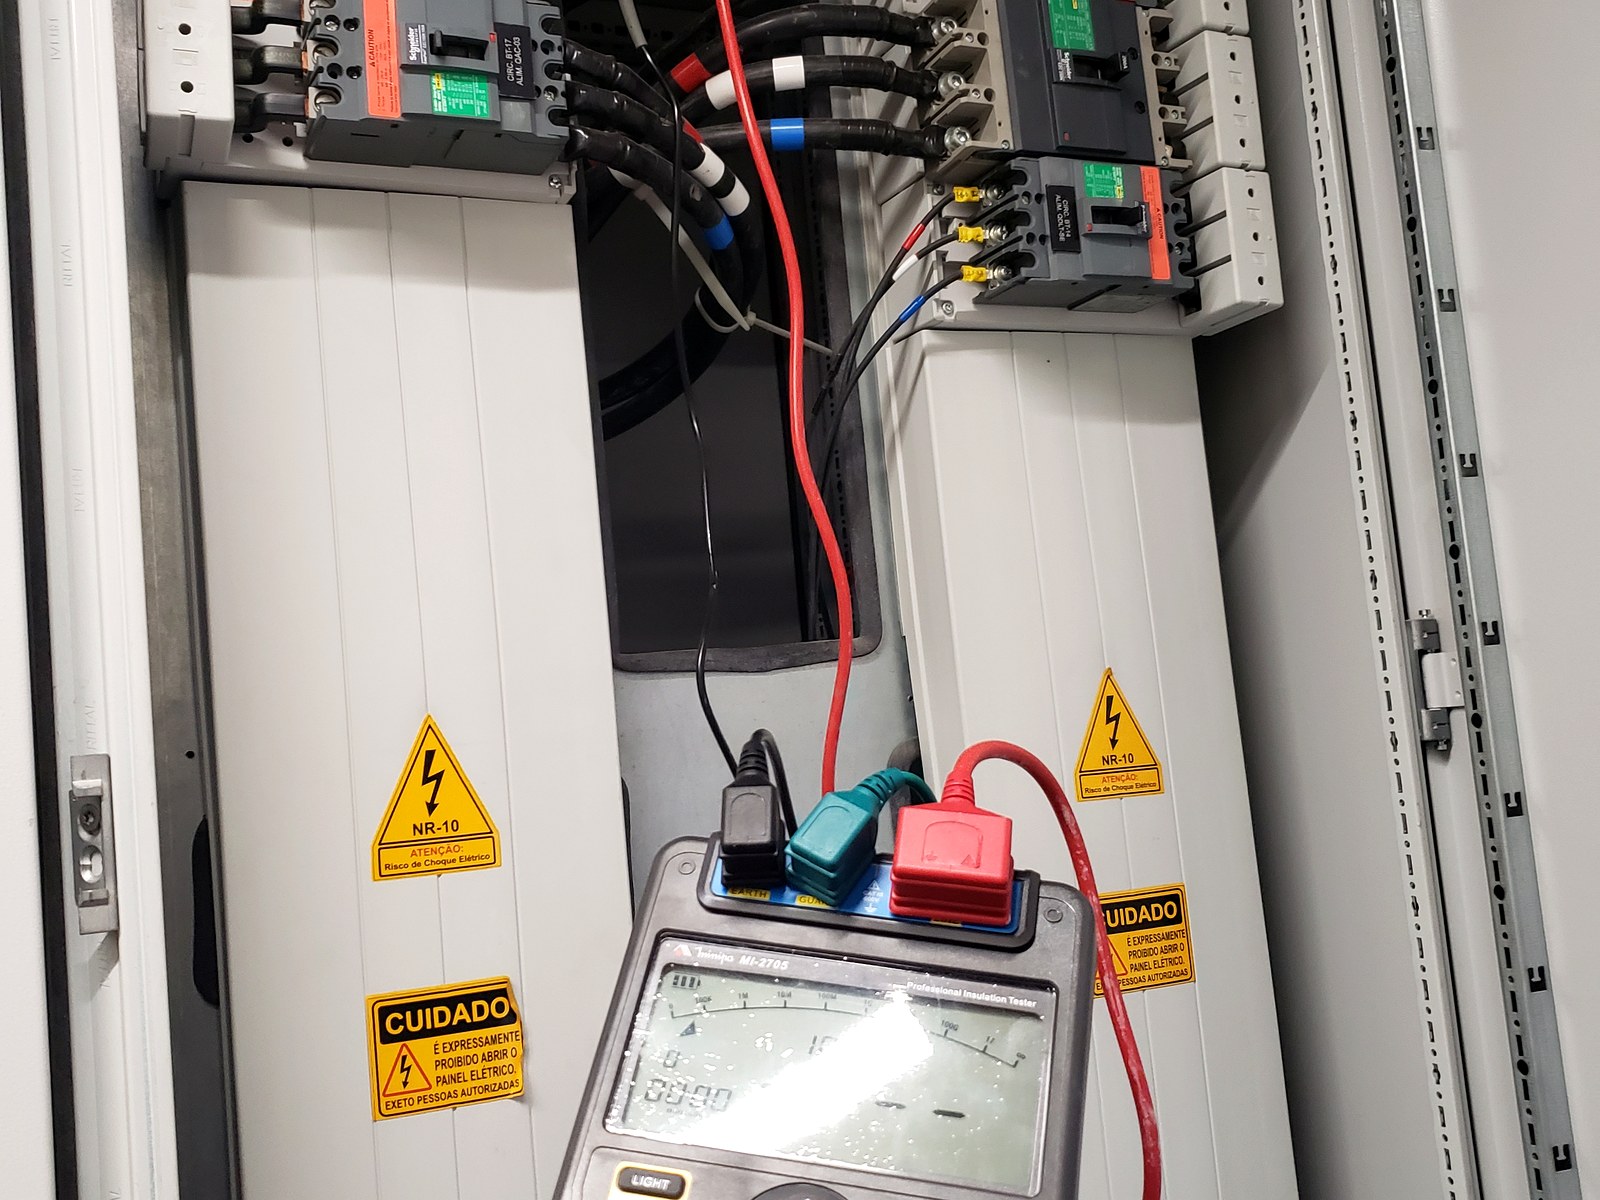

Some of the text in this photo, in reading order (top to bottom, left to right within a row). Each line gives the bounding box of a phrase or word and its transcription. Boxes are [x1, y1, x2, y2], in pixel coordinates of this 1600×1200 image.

[367, 29, 375, 61] CAUTION
[407, 27, 420, 61] Schneider
[504, 38, 513, 60] BT-17
[1102, 753, 1134, 766] NR-10
[1102, 773, 1138, 784] ATENÇÃO:
[1112, 784, 1134, 792] Choque
[412, 820, 459, 836] NR-10
[410, 844, 464, 858] ATENÇÃO:
[384, 862, 409, 871] Risco
[424, 858, 456, 867] Choque
[459, 854, 490, 863] Elétrico
[731, 886, 767, 898] EARTH
[799, 896, 824, 904] GUA
[1105, 901, 1178, 928] UIDADO
[1127, 929, 1186, 946] É EXPRESSAMENTE
[1129, 943, 1184, 959] PROIBIDO ABRIR O
[739, 955, 790, 970] MI-2705
[1130, 956, 1185, 972] PAINEL ELÉTRICO.
[1119, 968, 1188, 986] PESSOAS AUTORIZADAS
[906, 982, 1037, 1008] Professional Insulation Tester
[385, 996, 510, 1035] CUIDADO
[434, 1030, 520, 1055] É EXPRESSAMENTE
[435, 1047, 517, 1070] PROIBIDO ABRIR O
[436, 1064, 516, 1087] PAINEL ELÉTRICO.
[386, 1079, 519, 1110] EXETO PESSOAS AUTORIZADAS
[630, 1174, 671, 1190] LIGHT
